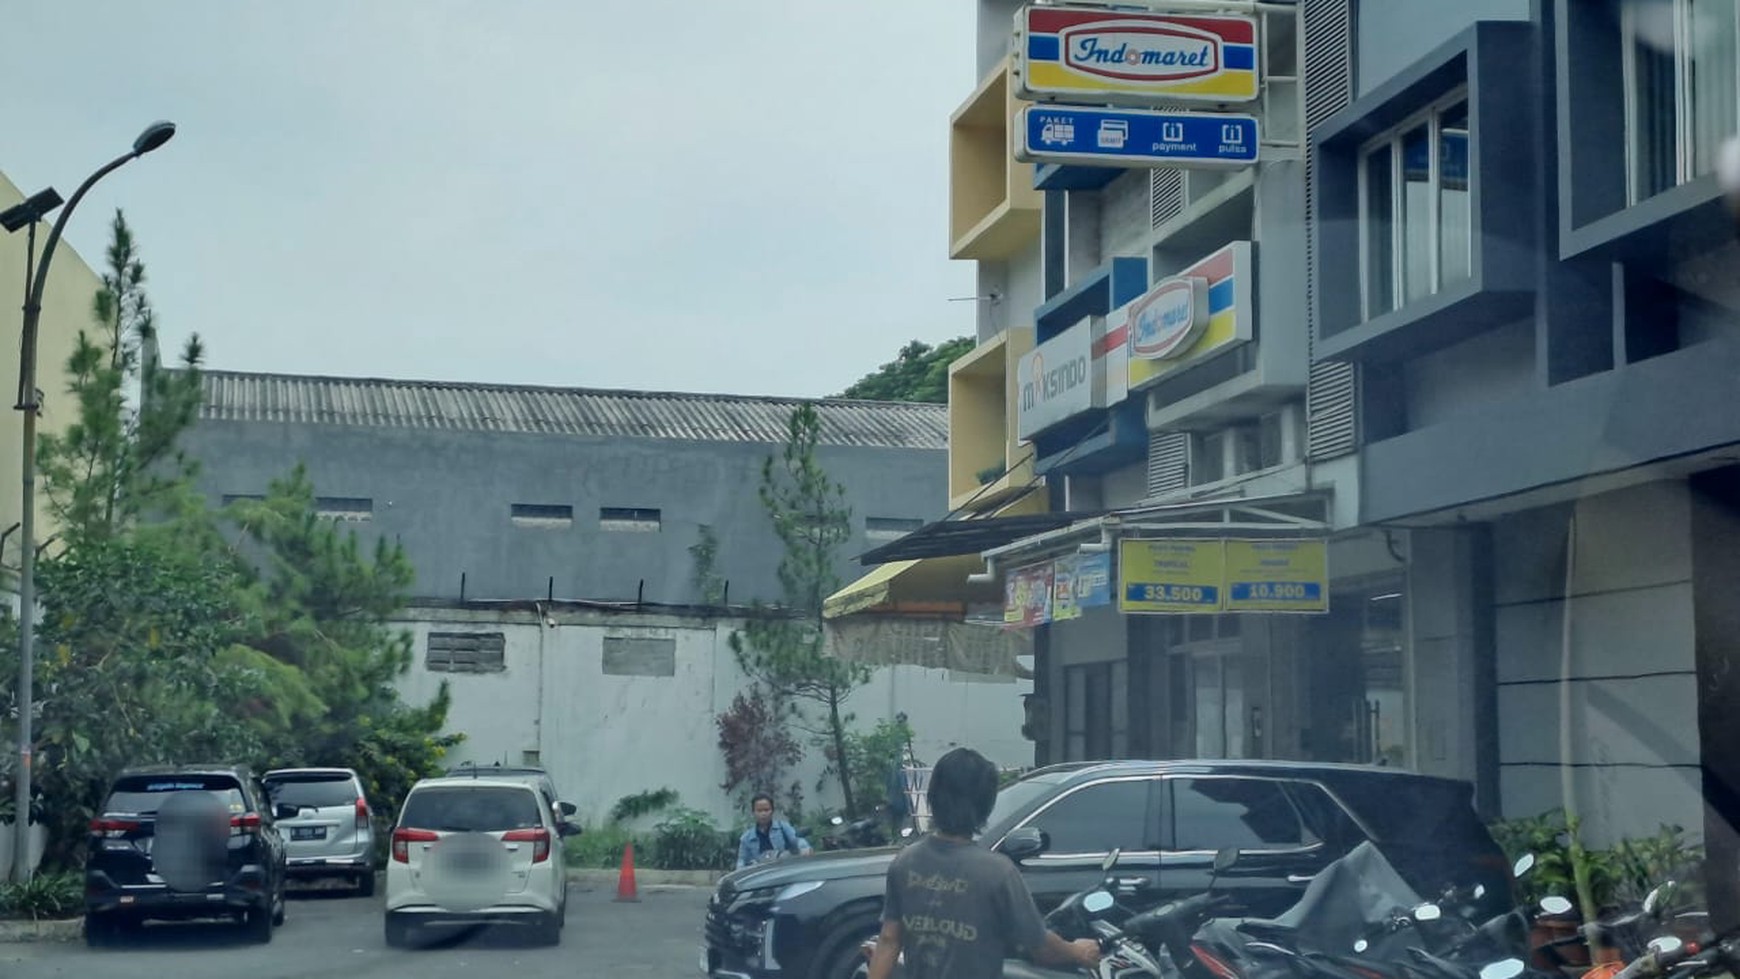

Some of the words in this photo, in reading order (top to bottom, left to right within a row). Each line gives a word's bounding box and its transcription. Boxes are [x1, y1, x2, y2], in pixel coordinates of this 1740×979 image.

[1074, 37, 1208, 67] Indomaret
[1039, 116, 1074, 125] PAKET
[1152, 142, 1197, 152] payment
[1218, 144, 1248, 153] pulsa
[1143, 585, 1202, 601] 33.500
[1249, 584, 1305, 599] 10.900
